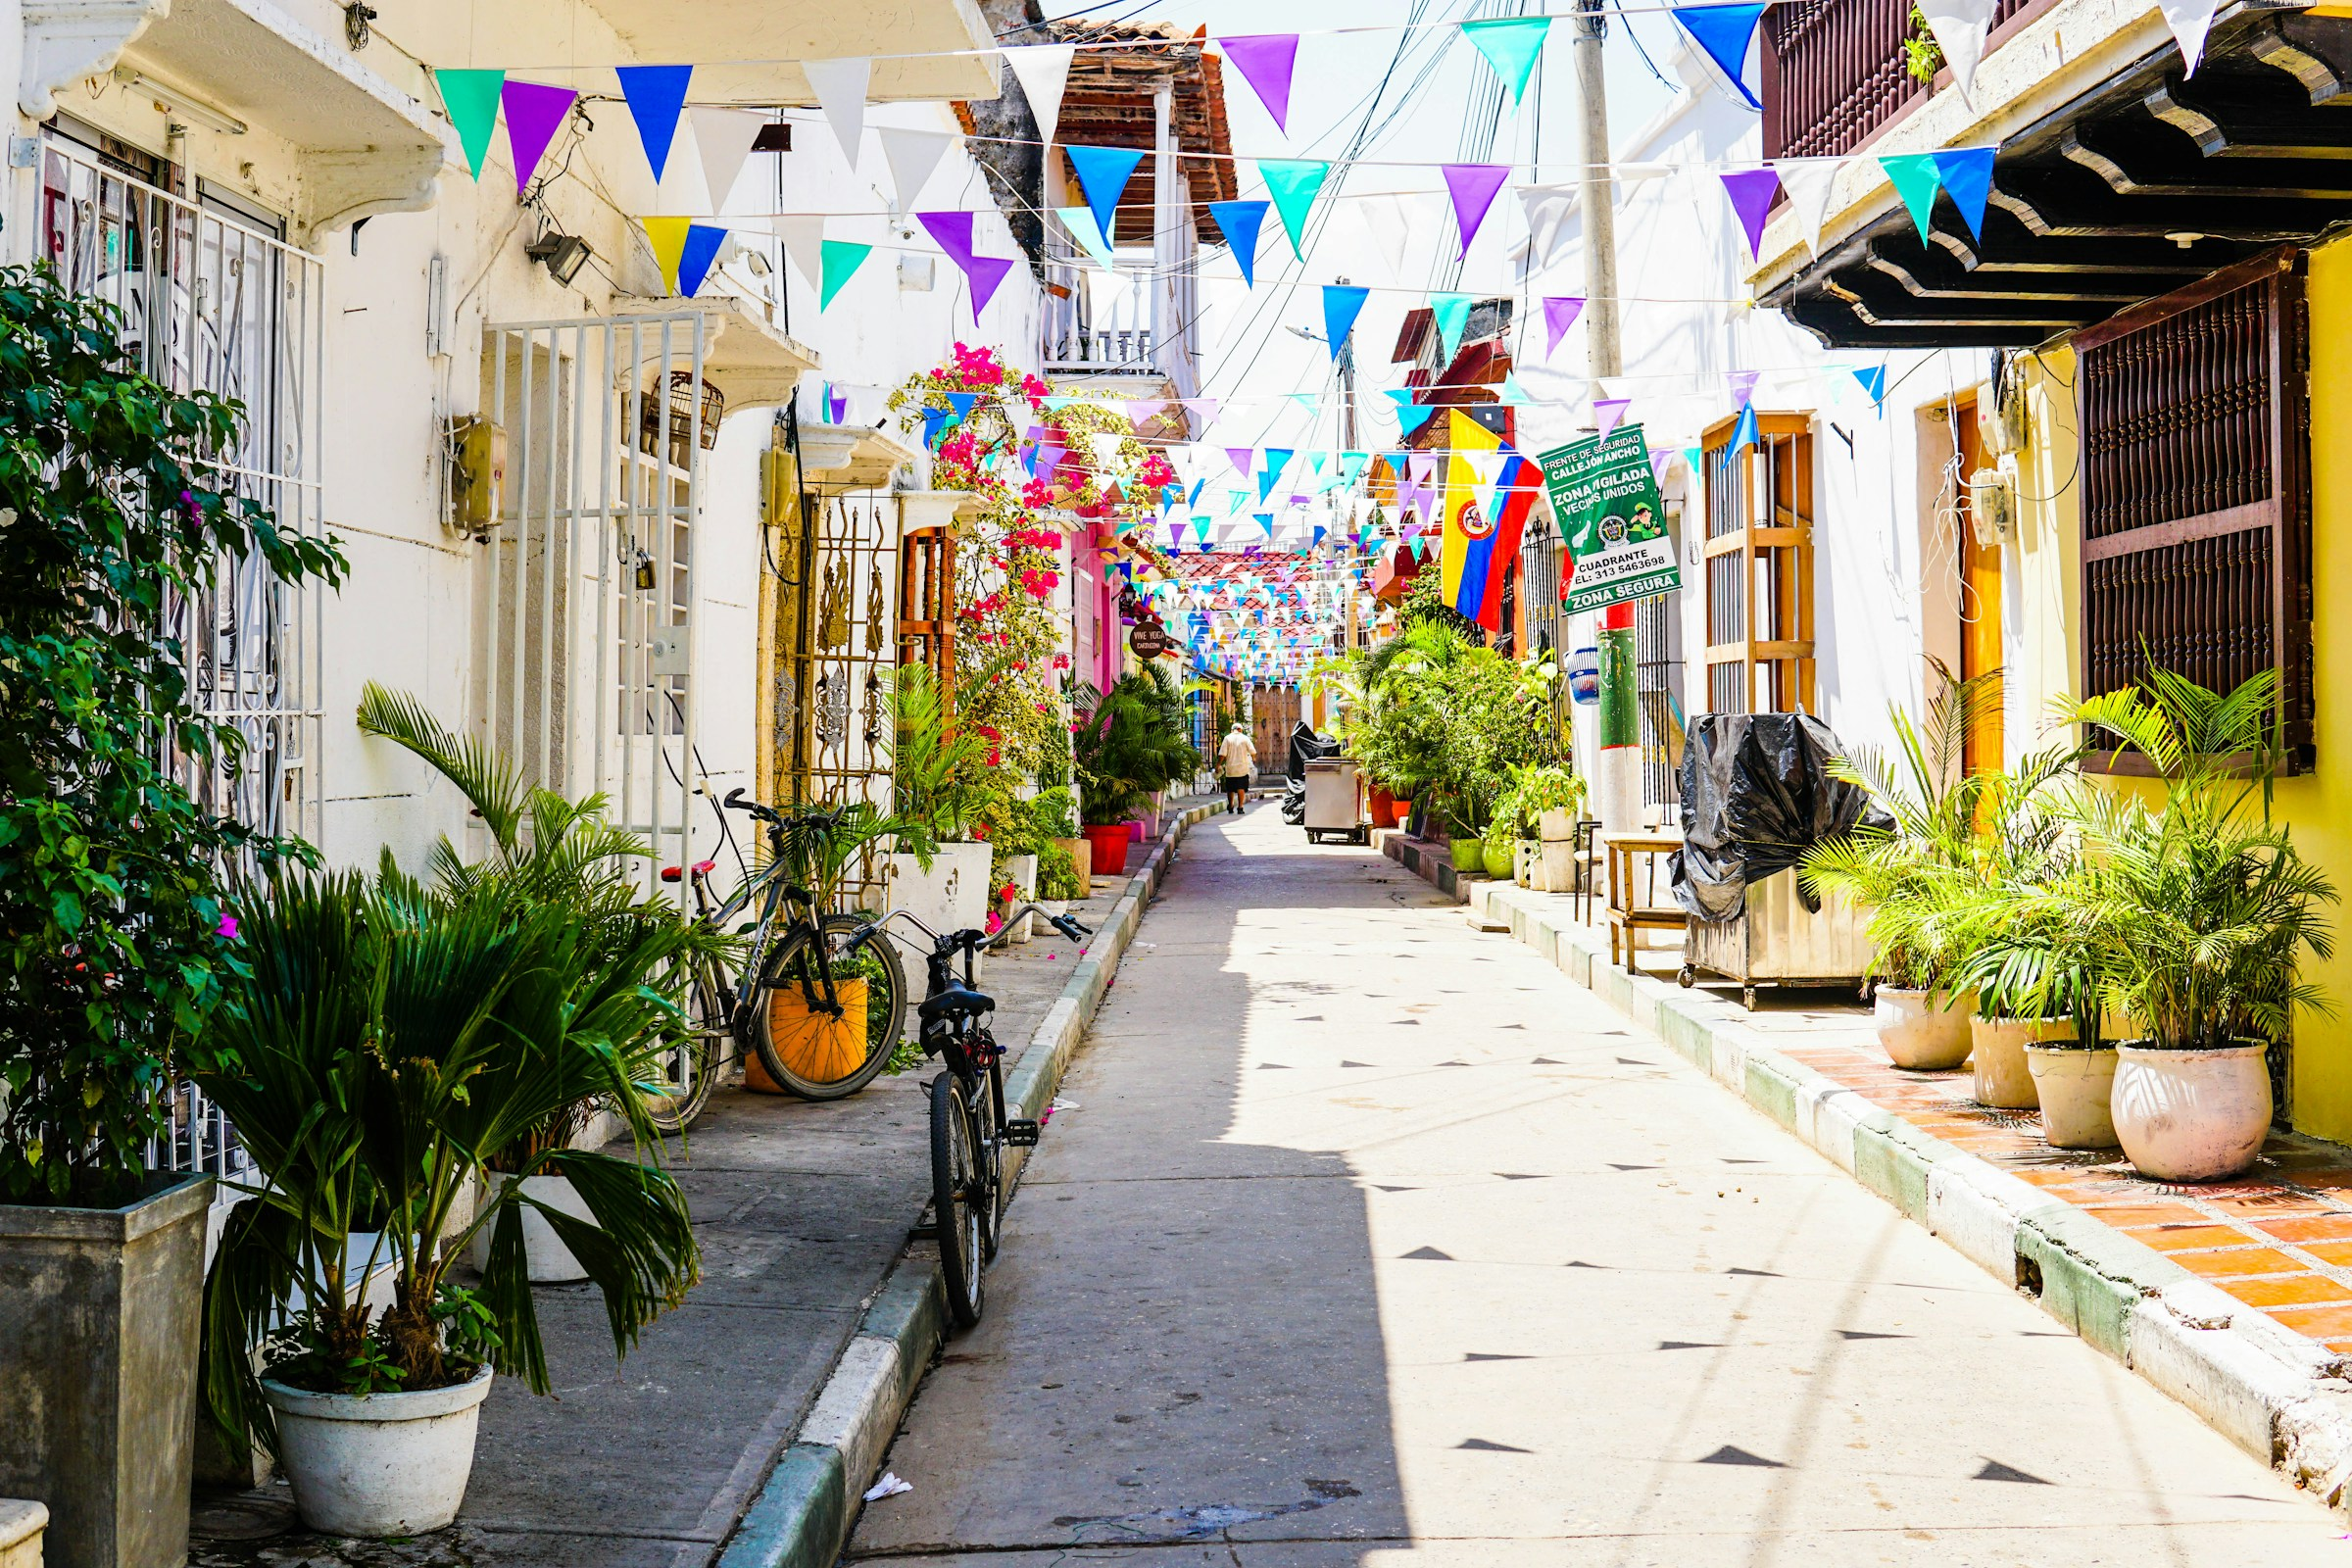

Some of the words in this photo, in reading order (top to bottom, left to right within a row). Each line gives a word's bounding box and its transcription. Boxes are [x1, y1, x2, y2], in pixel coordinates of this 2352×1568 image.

[1544, 453, 1578, 471] FRENTE
[1579, 449, 1592, 460] DE
[1593, 434, 1641, 455] SEGURIDAD
[1604, 445, 1641, 464] ANCHO
[1553, 484, 1592, 507] ZONA
[1603, 481, 1645, 501] UNIDOS
[1575, 574, 1592, 585] EL:
[1594, 567, 1616, 580] 313
[1618, 556, 1665, 574] 5463698
[1579, 549, 1648, 572] CUADRANTE
[1571, 589, 1614, 609] ZONA
[1615, 574, 1675, 598] SEGURA
[1134, 631, 1147, 640] VIVE
[1149, 631, 1164, 640] YOGA
